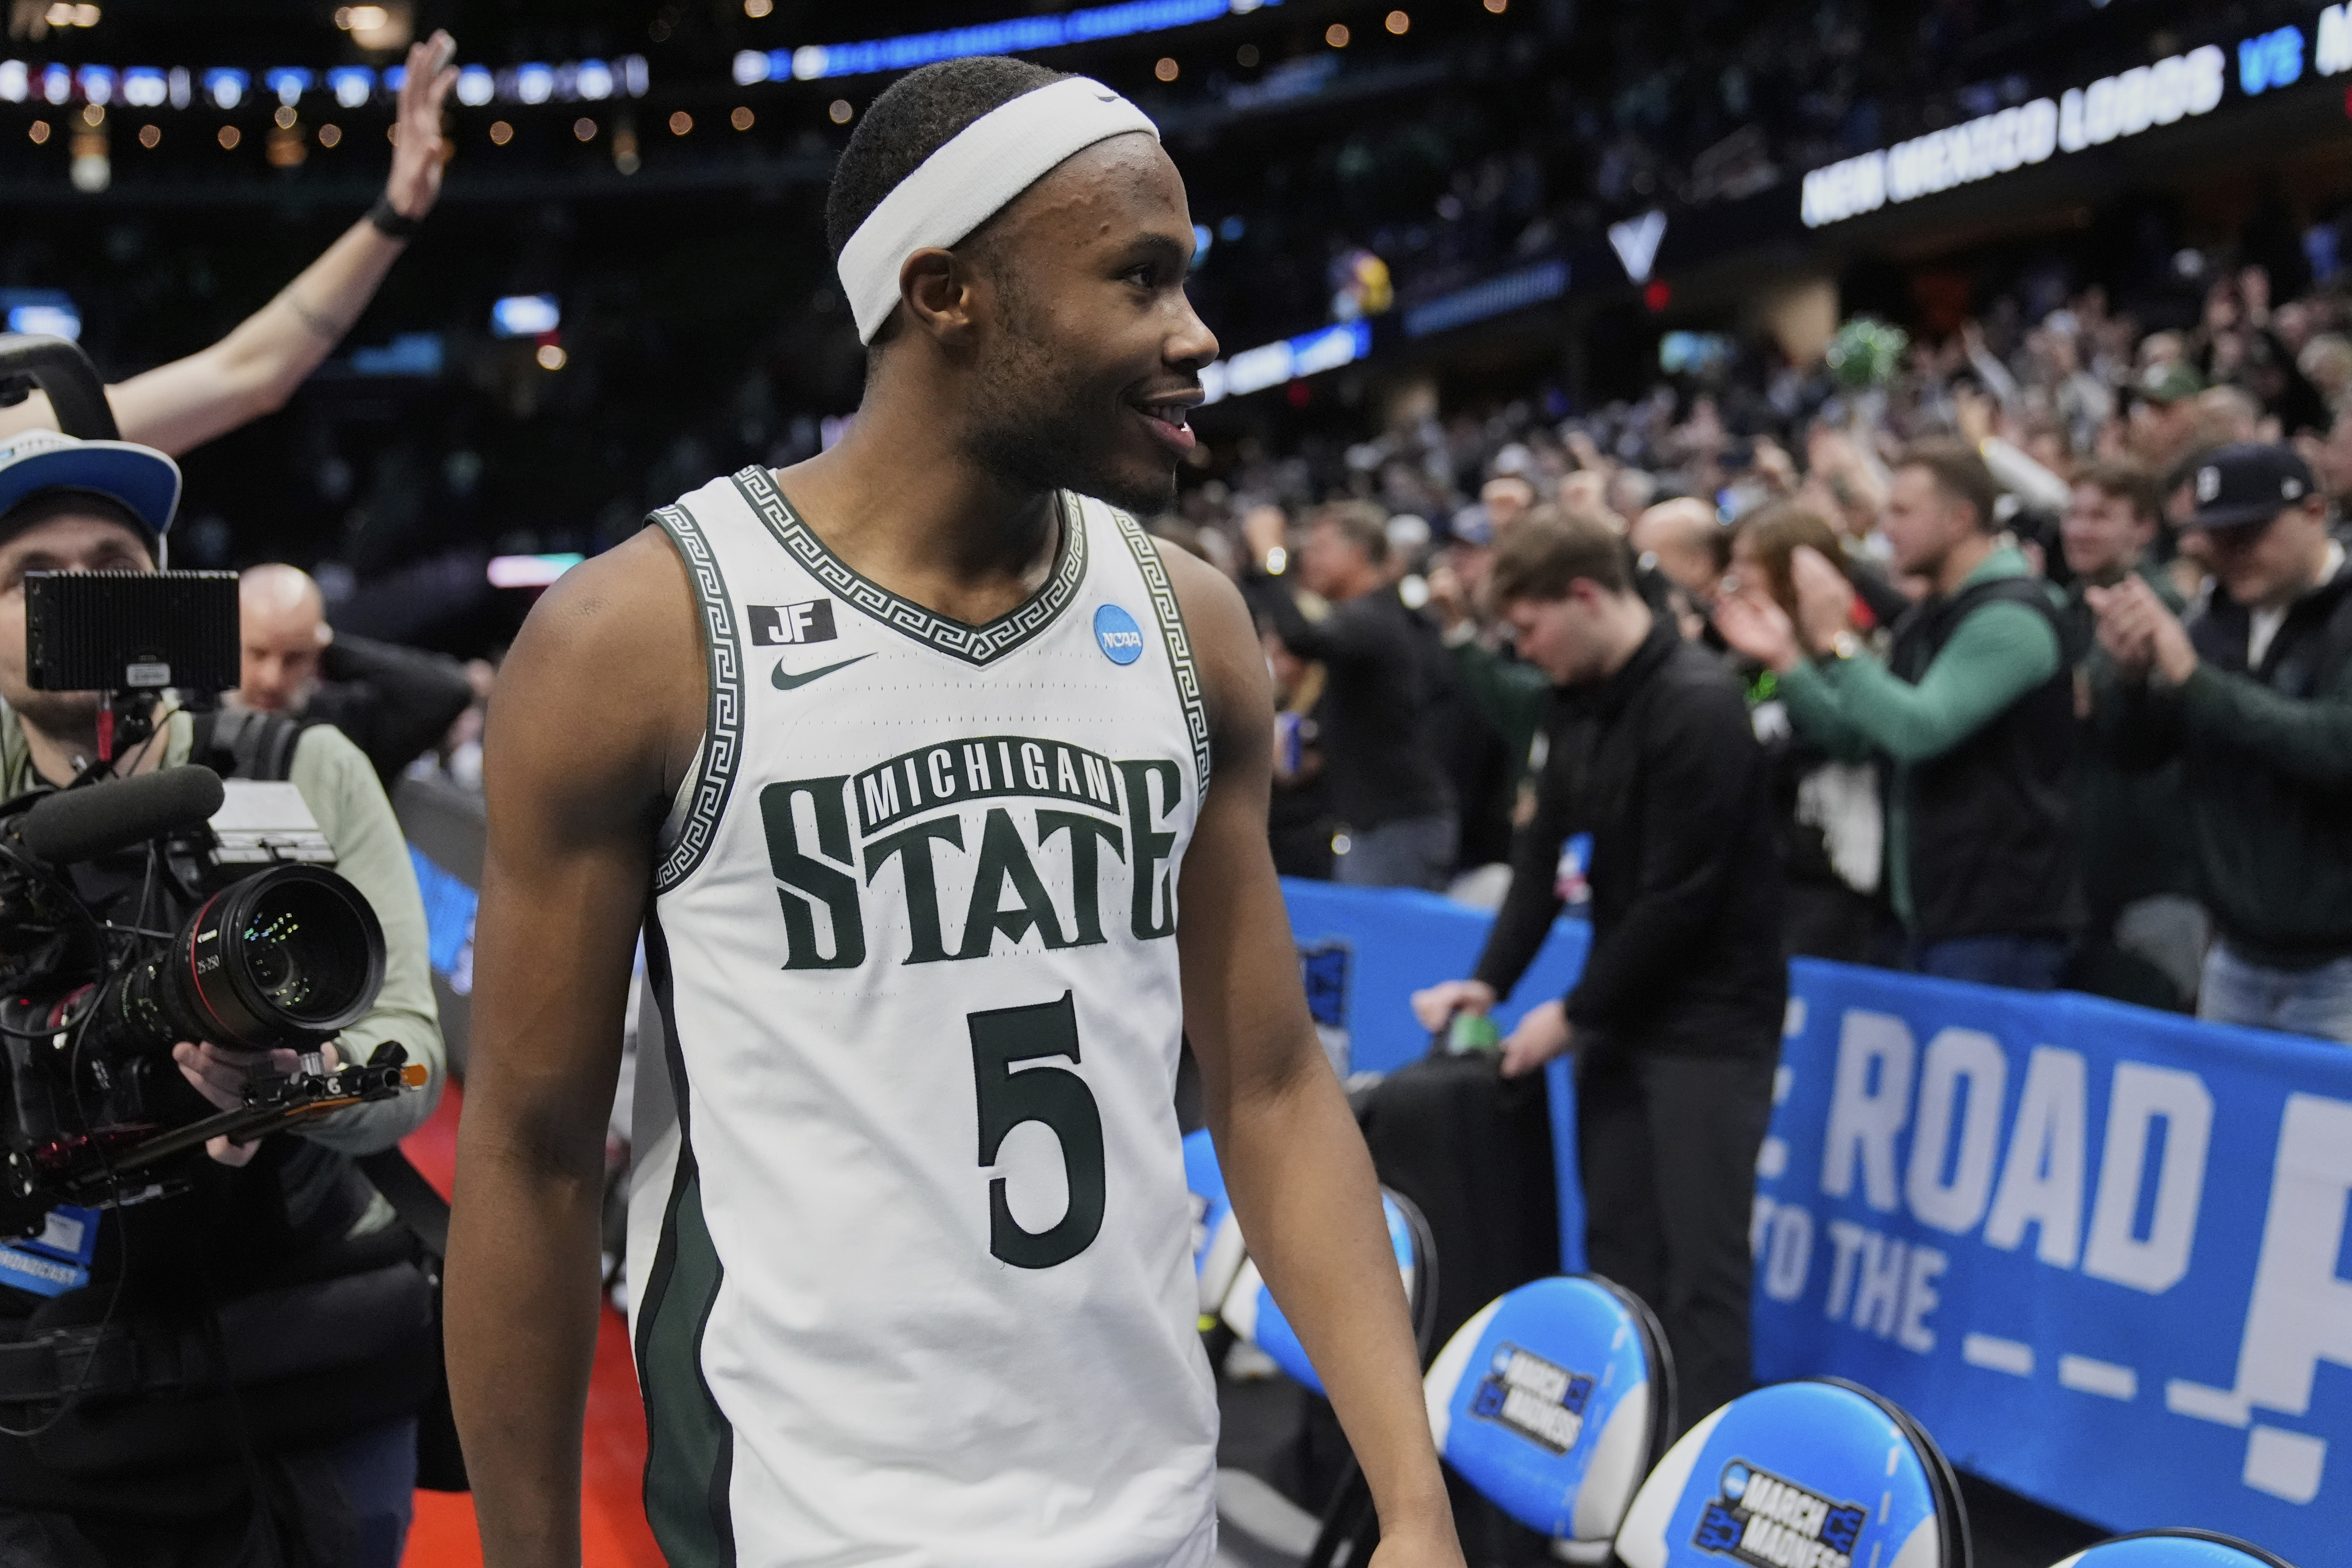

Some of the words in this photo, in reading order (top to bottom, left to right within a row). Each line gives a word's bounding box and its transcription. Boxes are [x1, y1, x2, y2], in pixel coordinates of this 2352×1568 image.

[1802, 149, 1887, 227] NEW
[2058, 44, 2225, 154] LOBOS
[768, 602, 814, 643] JF
[1102, 632, 1142, 648] NCAA
[863, 742, 1112, 827] MICHIGAN
[760, 759, 1181, 970] STATE
[967, 989, 1105, 1269] 5
[1820, 1008, 2215, 1295] ROAD
[1825, 1218, 1949, 1355] THE
[1740, 1472, 1828, 1538] MARCH
